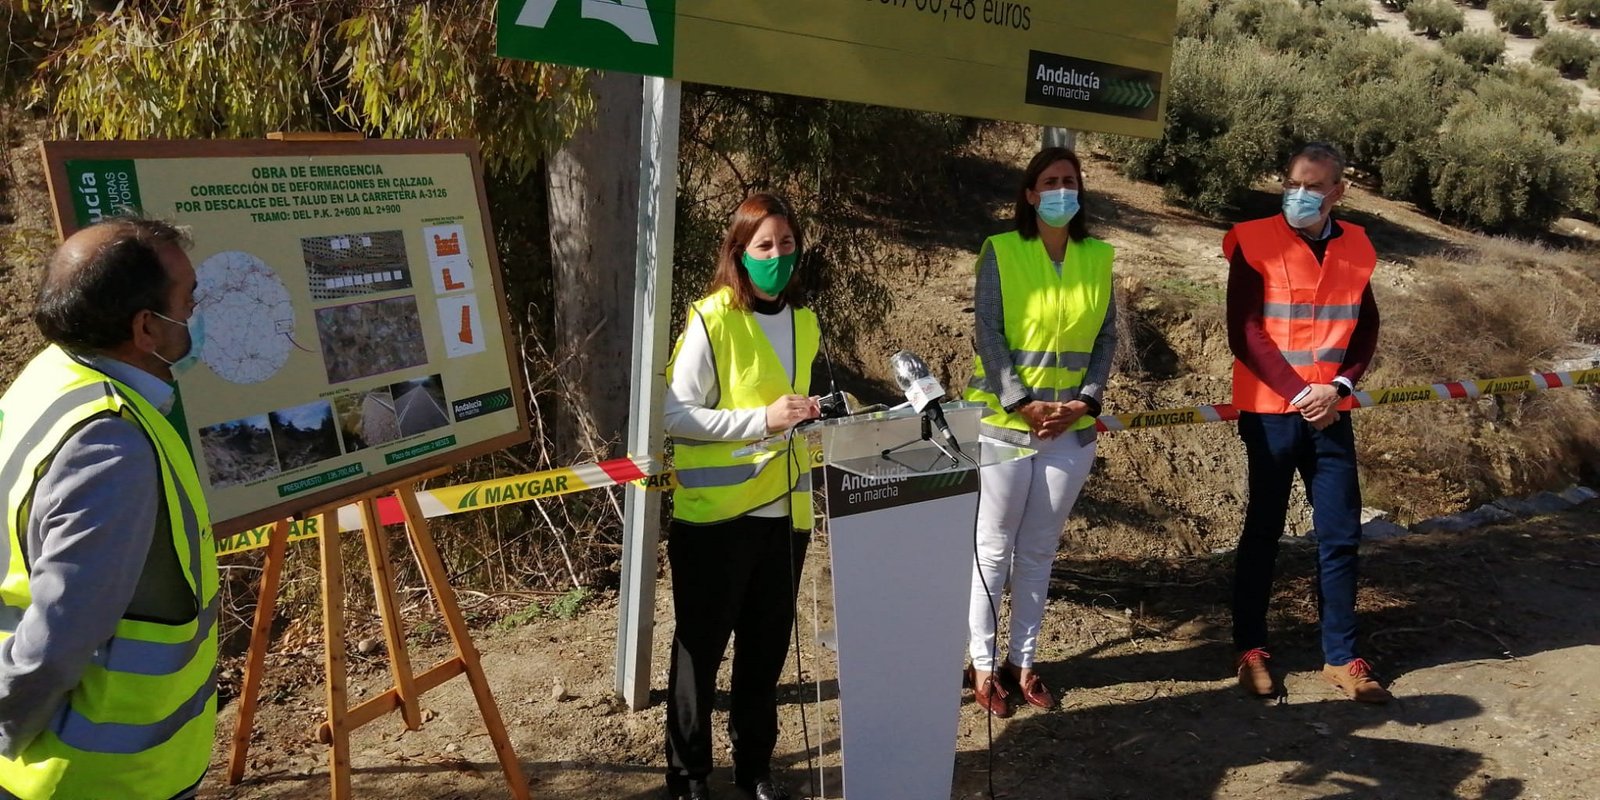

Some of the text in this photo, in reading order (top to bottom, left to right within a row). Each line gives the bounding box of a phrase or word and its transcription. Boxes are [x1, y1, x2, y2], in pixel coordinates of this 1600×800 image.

[983, 2, 1031, 31] euros
[1036, 63, 1100, 89] Andalucía
[1042, 84, 1090, 101] en marcha
[251, 164, 383, 179] OBRA DE EMERGENCIA
[190, 177, 434, 197] CORRECCIÓN DE DEFORMACIONES EN CALZADA
[175, 188, 448, 212] POR DESCALCE DEL TALUD EN LA CARRETERA A-3126
[250, 204, 401, 223] TRAMO: DEL P.K. 2+600 AL 2+900
[1391, 389, 1430, 403] MAYGAR
[1494, 380, 1530, 393] MAYGAR
[1145, 411, 1194, 427] MAYGAR
[485, 475, 568, 504] MAYGAR
[848, 484, 898, 504] en marcha
